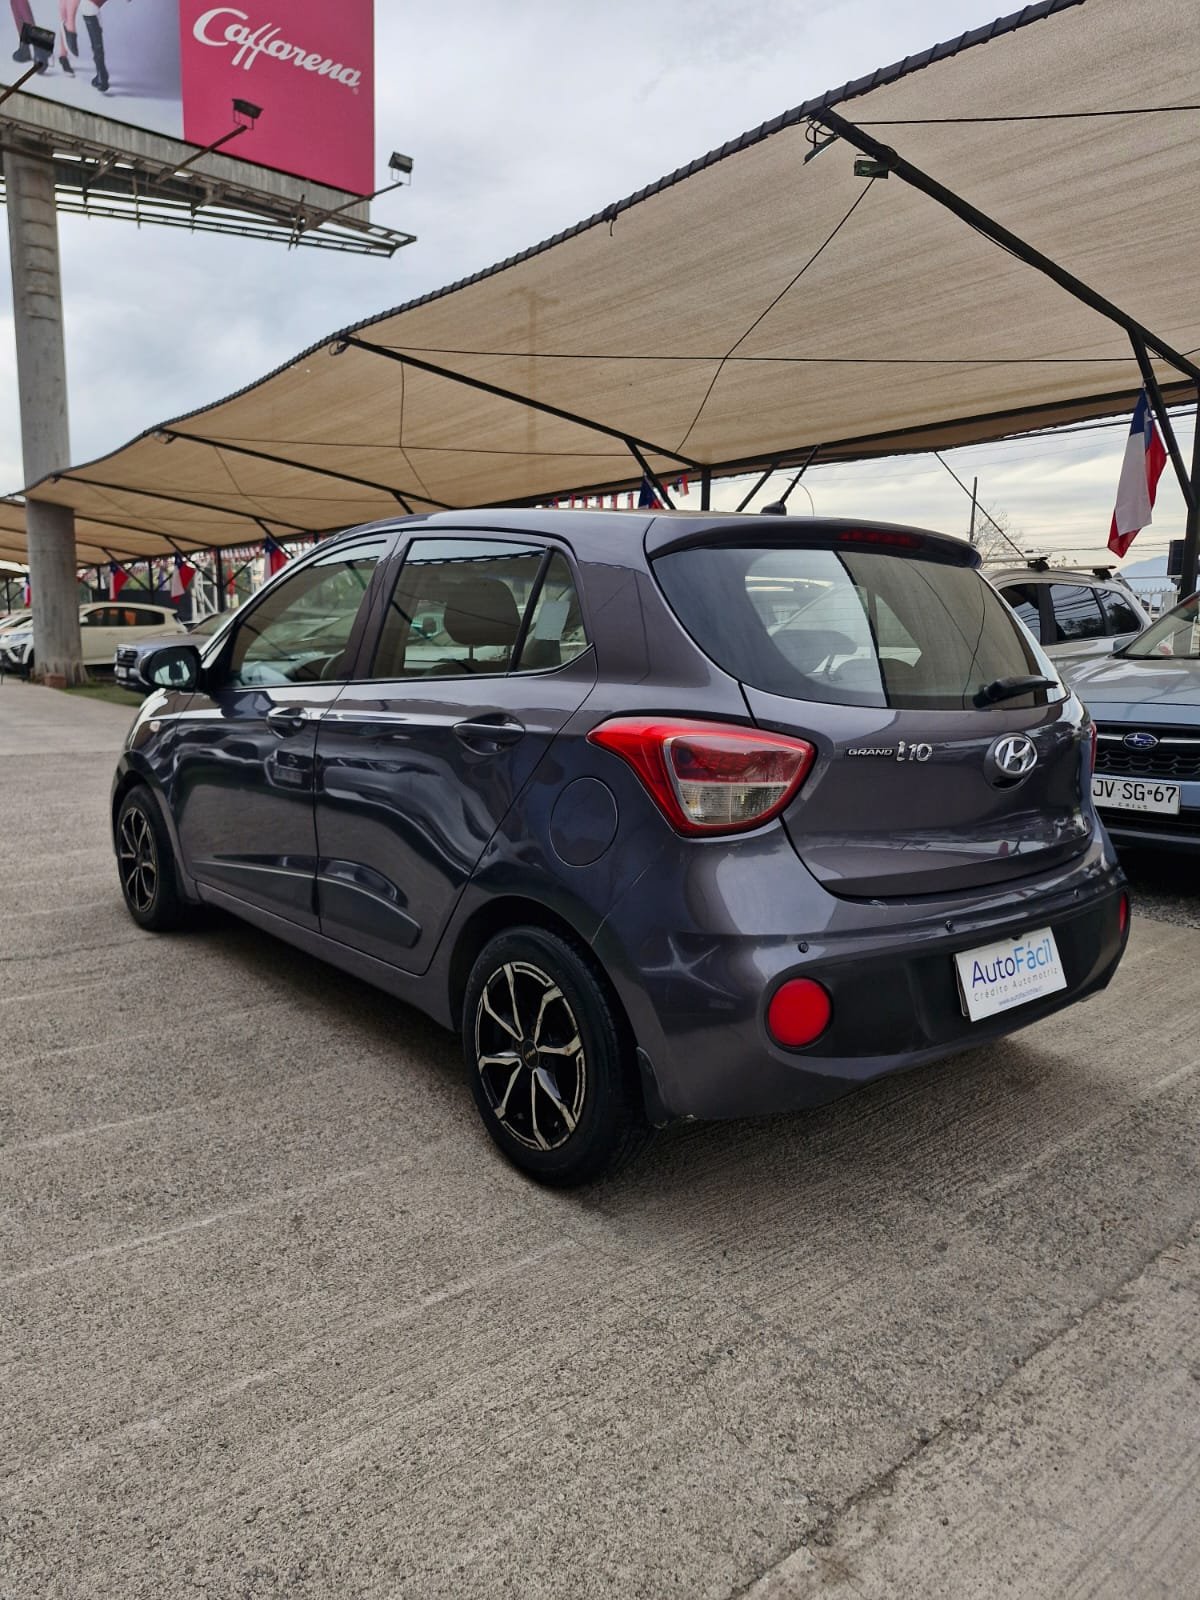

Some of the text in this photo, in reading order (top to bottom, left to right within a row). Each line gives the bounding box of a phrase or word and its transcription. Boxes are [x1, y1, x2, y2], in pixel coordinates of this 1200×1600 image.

[192, 7, 362, 87] Caffarena
[848, 740, 932, 761] GRAND i10
[972, 938, 1053, 988] AutoFácil
[974, 984, 1009, 1002] Crédito
[1012, 967, 1058, 988] Automotriz
